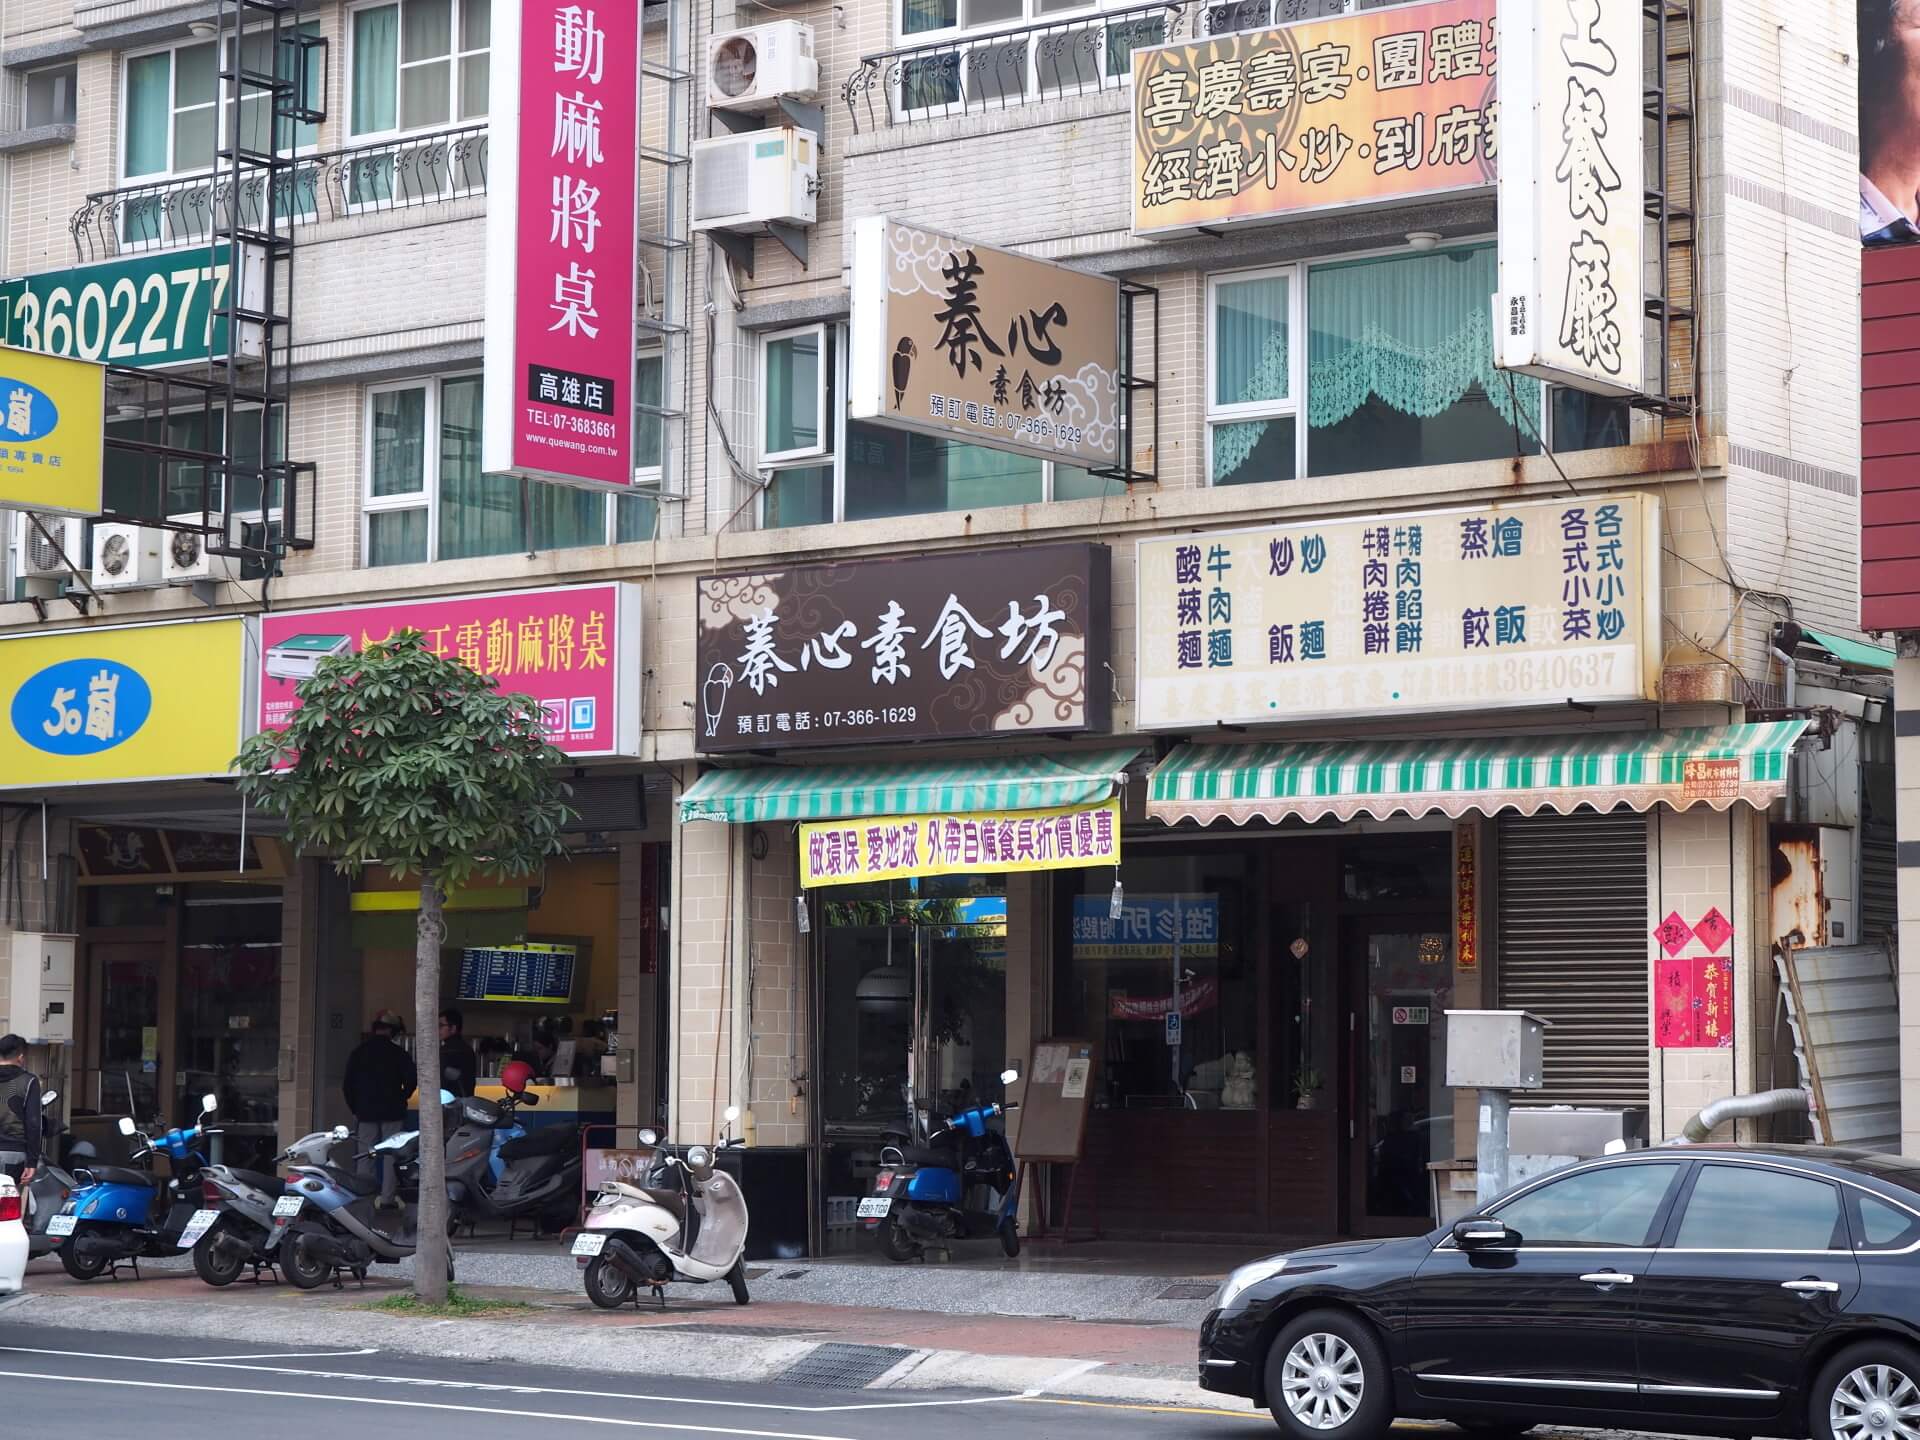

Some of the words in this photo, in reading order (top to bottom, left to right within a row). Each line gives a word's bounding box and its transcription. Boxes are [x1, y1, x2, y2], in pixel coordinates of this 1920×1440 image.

[525, 433, 618, 457] www.quewang.com.tw
[539, 372, 604, 410] 高雄店
[989, 364, 1068, 417] 素食坊
[1175, 545, 1203, 670] 酸辣麵
[1207, 543, 1233, 669] 牛肉麵
[1268, 537, 1295, 664] 炒飯
[1300, 533, 1327, 662] 炒麵
[1460, 517, 1491, 649] 蒸餃
[1491, 516, 1527, 646] 燴飯
[1561, 508, 1592, 642] 各式小菜
[1594, 504, 1626, 641] 各式小炒
[736, 593, 1067, 697] 蓁心素食坊
[808, 827, 861, 878] 做環保
[866, 821, 919, 873] 愛地球
[927, 808, 1114, 867] 外帶自備餐具折價優惠
